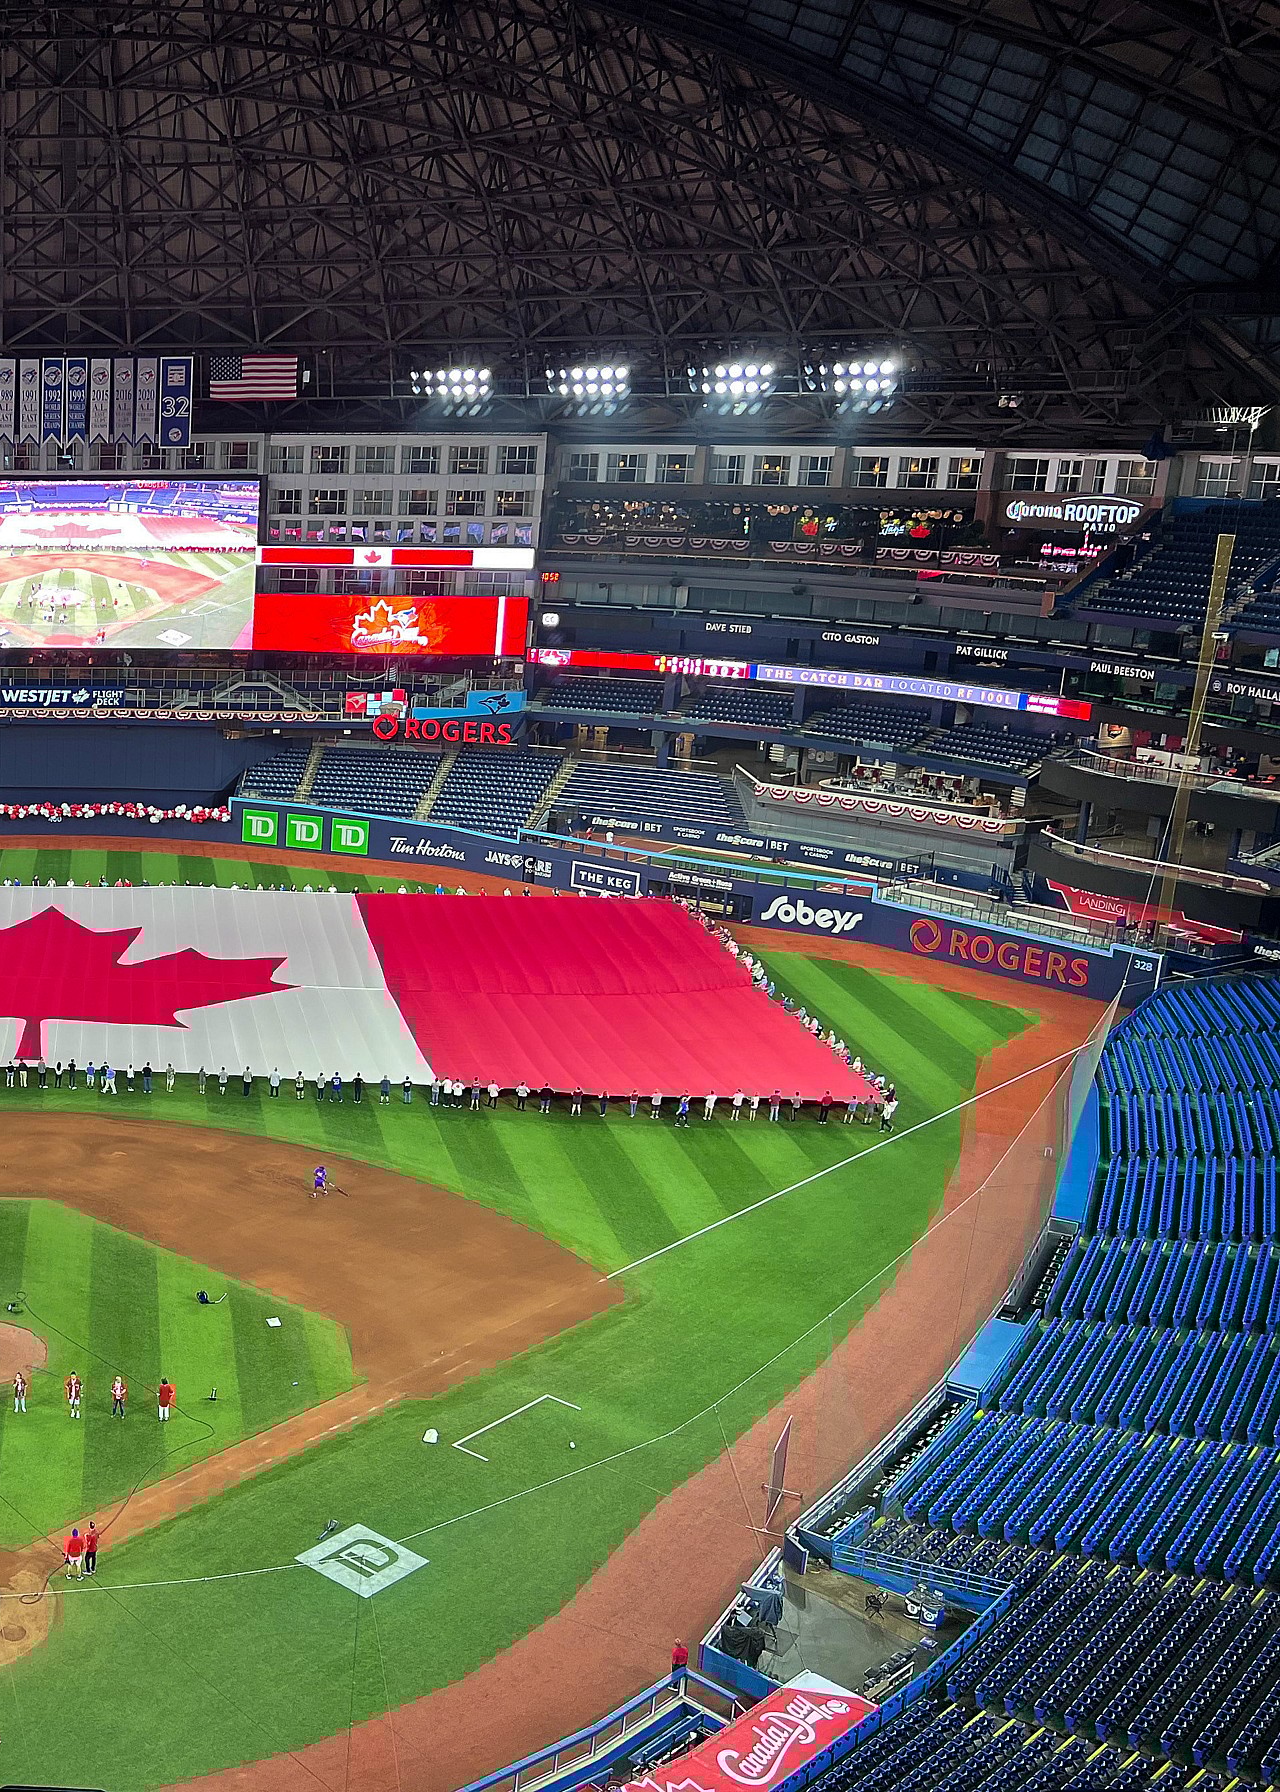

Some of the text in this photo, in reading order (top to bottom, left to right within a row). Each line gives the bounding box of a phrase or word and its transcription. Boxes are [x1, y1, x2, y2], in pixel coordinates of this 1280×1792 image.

[22, 389, 37, 401] 1991
[45, 389, 60, 401] 1992
[69, 389, 85, 401] 1993
[92, 389, 108, 401] 2015
[116, 389, 131, 401] 2016
[138, 389, 154, 401] 2020
[162, 396, 190, 418] 32
[22, 414, 37, 422] EAST
[1006, 500, 1140, 524] Corona ROOFTOP
[1083, 523, 1116, 532] PATIO
[705, 623, 751, 634] DAVE STIEB
[822, 632, 879, 645] CITO GASTON
[956, 645, 1008, 660] PAT GILLICK
[1091, 662, 1154, 680] PAUL BEESTON
[765, 669, 793, 680] THE
[800, 672, 846, 684] CATCH
[854, 677, 884, 688] BAR
[890, 681, 951, 696] LOCATED
[957, 688, 973, 698] RF
[1227, 683, 1280, 701] ROY HALLA
[2, 690, 71, 706] WESTJET
[97, 698, 119, 706] DECK
[405, 718, 512, 744] ROGERS
[246, 816, 274, 838] TD
[291, 820, 319, 843] TD
[592, 816, 662, 833] theScore BET
[336, 825, 365, 847] TD
[716, 833, 789, 852] theScore BET
[390, 837, 414, 855] Tim
[485, 850, 552, 874] JAYS CARE
[809, 852, 829, 860] CASINO
[845, 853, 919, 874] theScore BET
[579, 870, 633, 889] THE KEG
[669, 872, 690, 881] Active
[1079, 896, 1123, 913] LANDING
[761, 895, 863, 934] Sobeys
[949, 929, 1089, 987] ROGERS
[1254, 945, 1280, 960] theS
[1134, 959, 1153, 972] 328
[717, 1694, 832, 1785] Canada Day
